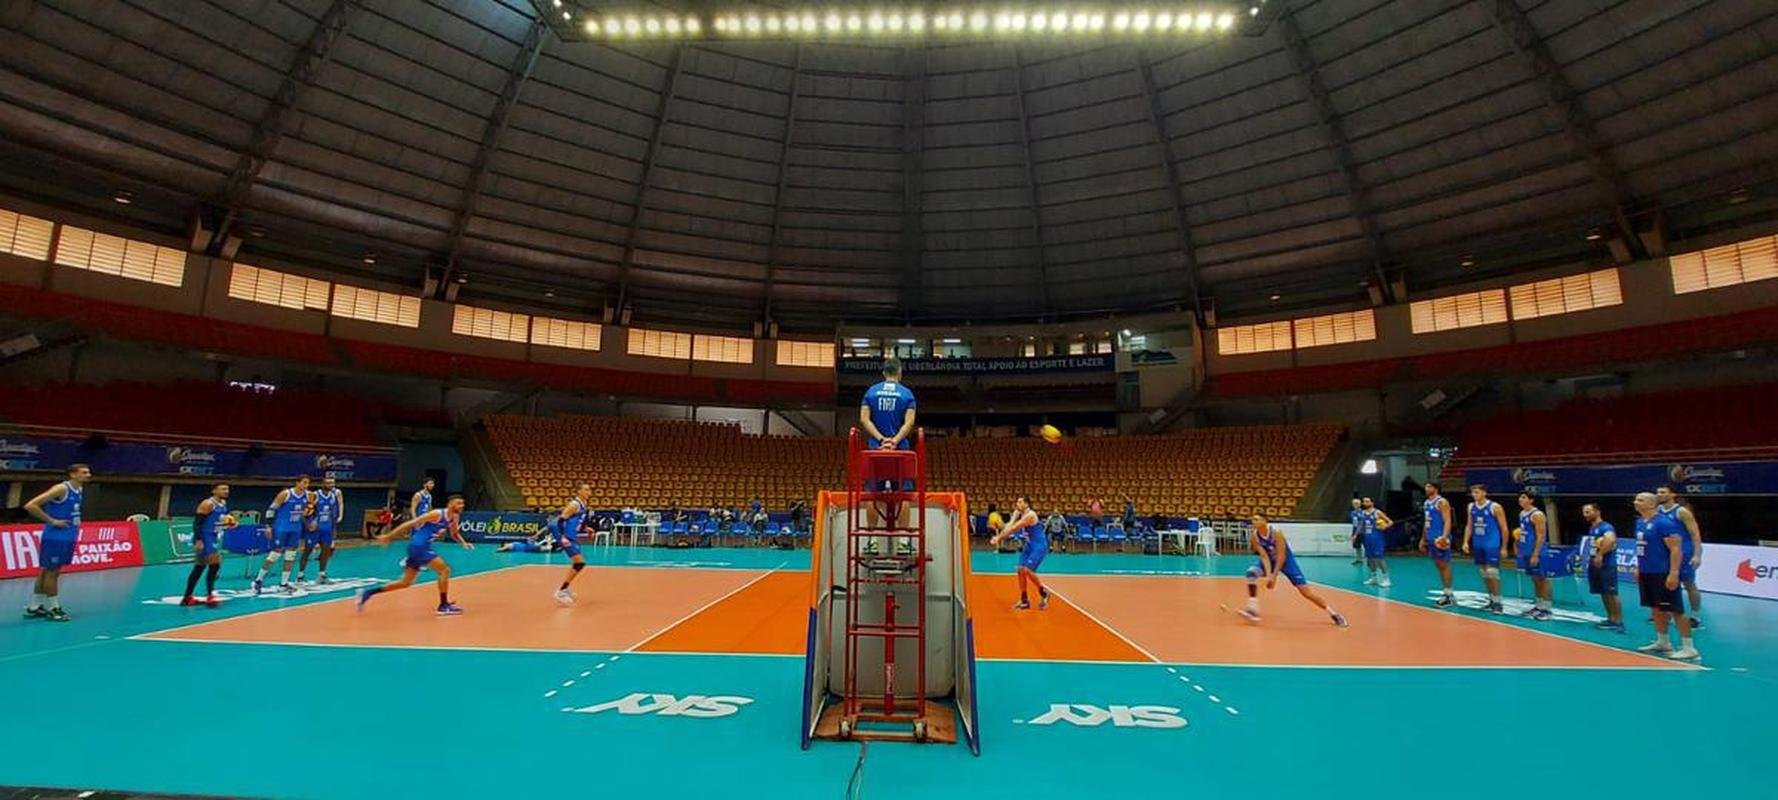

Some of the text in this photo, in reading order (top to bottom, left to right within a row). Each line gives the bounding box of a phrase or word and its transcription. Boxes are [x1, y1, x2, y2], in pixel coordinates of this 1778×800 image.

[845, 360, 883, 370] PREFEITU
[988, 361, 1015, 370] APOIO
[1015, 360, 1028, 370] AO
[1028, 359, 1068, 369] ESPORTE
[501, 522, 540, 533] BRASIL
[1, 530, 44, 570] IA
[79, 540, 132, 554] PAIXÃO
[574, 692, 755, 718] SKY
[1027, 703, 1188, 728] SKY
